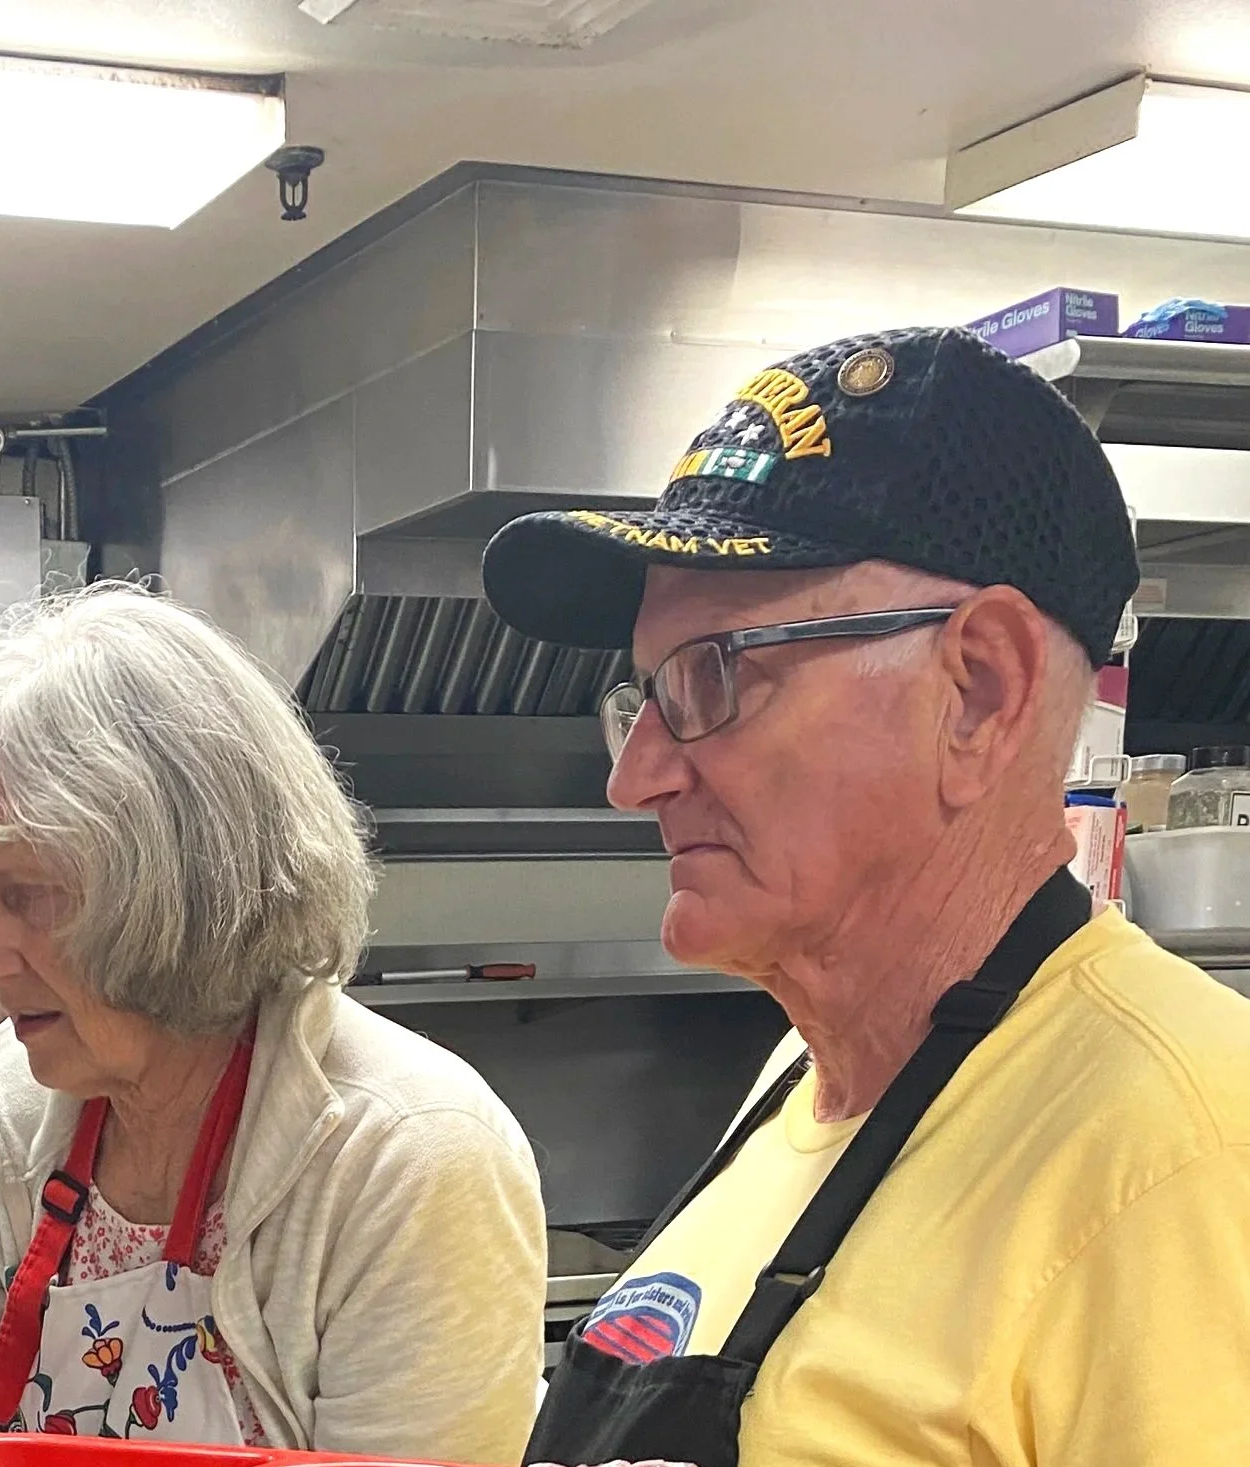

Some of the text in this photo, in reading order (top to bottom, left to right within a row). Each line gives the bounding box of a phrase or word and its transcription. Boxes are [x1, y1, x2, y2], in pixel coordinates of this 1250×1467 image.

[1065, 293, 1094, 307] Nitrile
[1002, 301, 1050, 330] Gloves
[1065, 304, 1097, 320] Gloves
[1184, 320, 1223, 333] Gloves
[707, 537, 774, 555] VET
